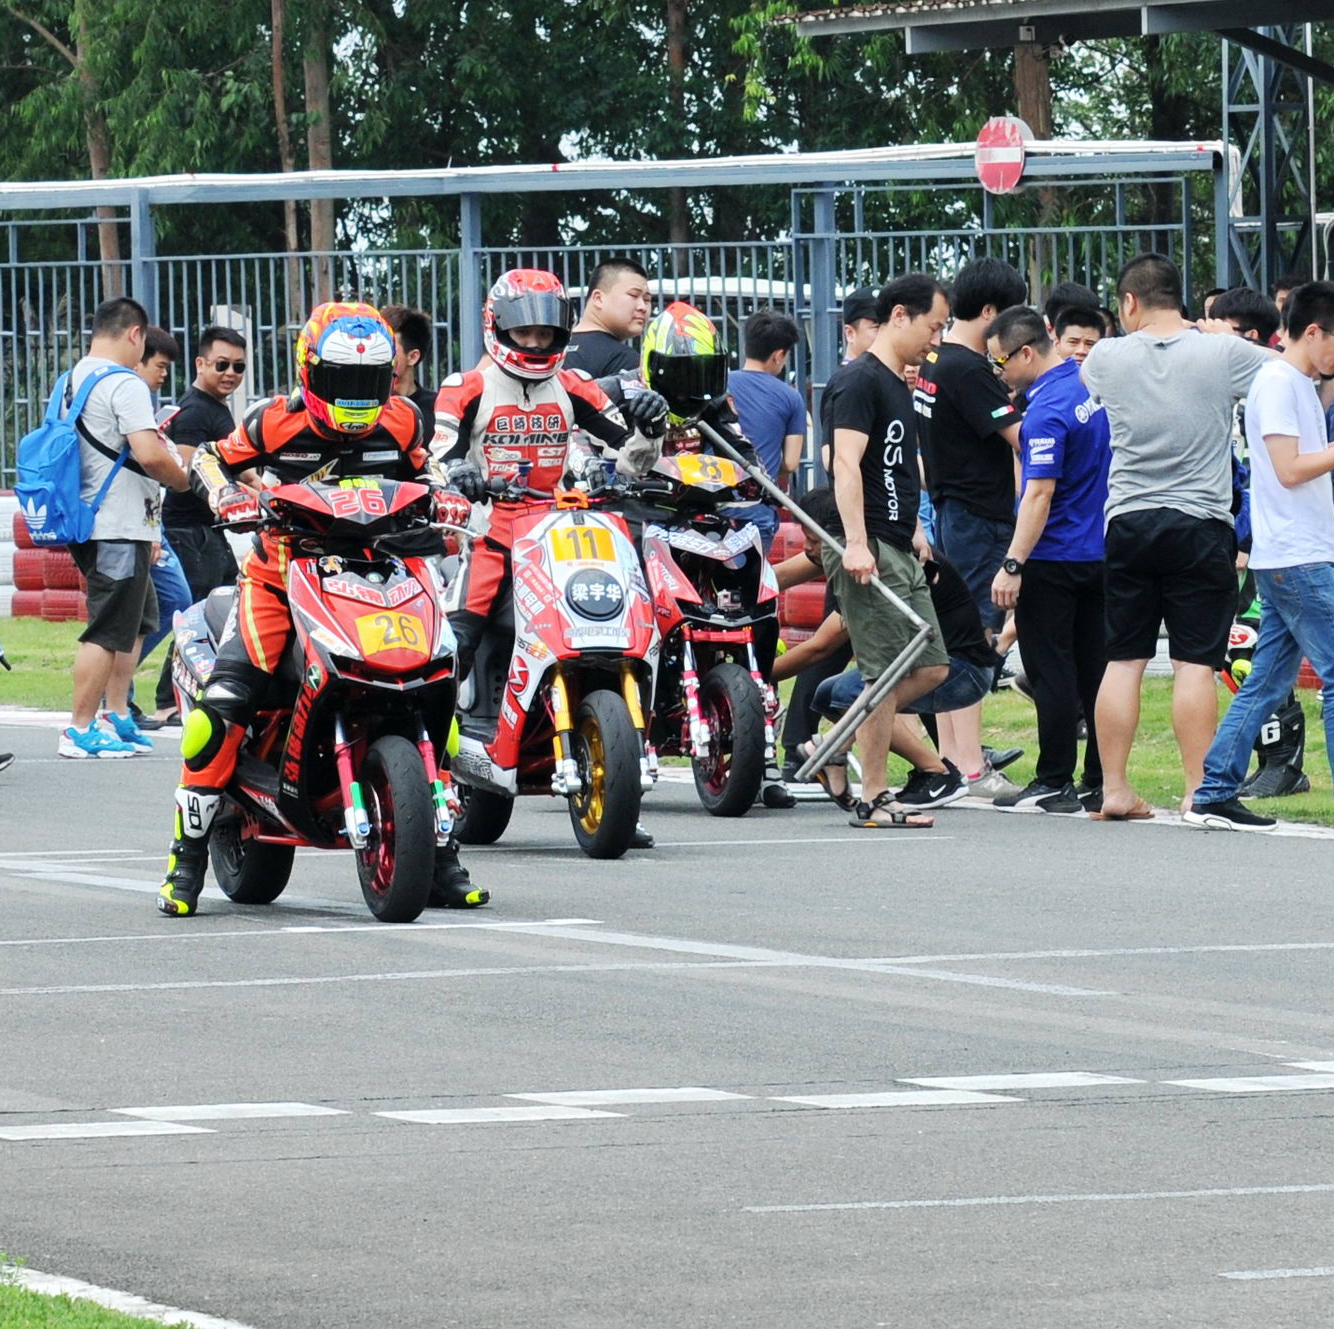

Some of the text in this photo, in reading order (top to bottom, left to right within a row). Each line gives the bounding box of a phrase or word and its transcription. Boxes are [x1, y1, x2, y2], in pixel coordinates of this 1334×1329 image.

[698, 455, 723, 480] 8
[883, 419, 905, 521] QS MOTOR
[328, 488, 388, 519] 26
[566, 528, 598, 560] 11
[571, 582, 623, 603] 梁宇华
[374, 615, 419, 646] 26
